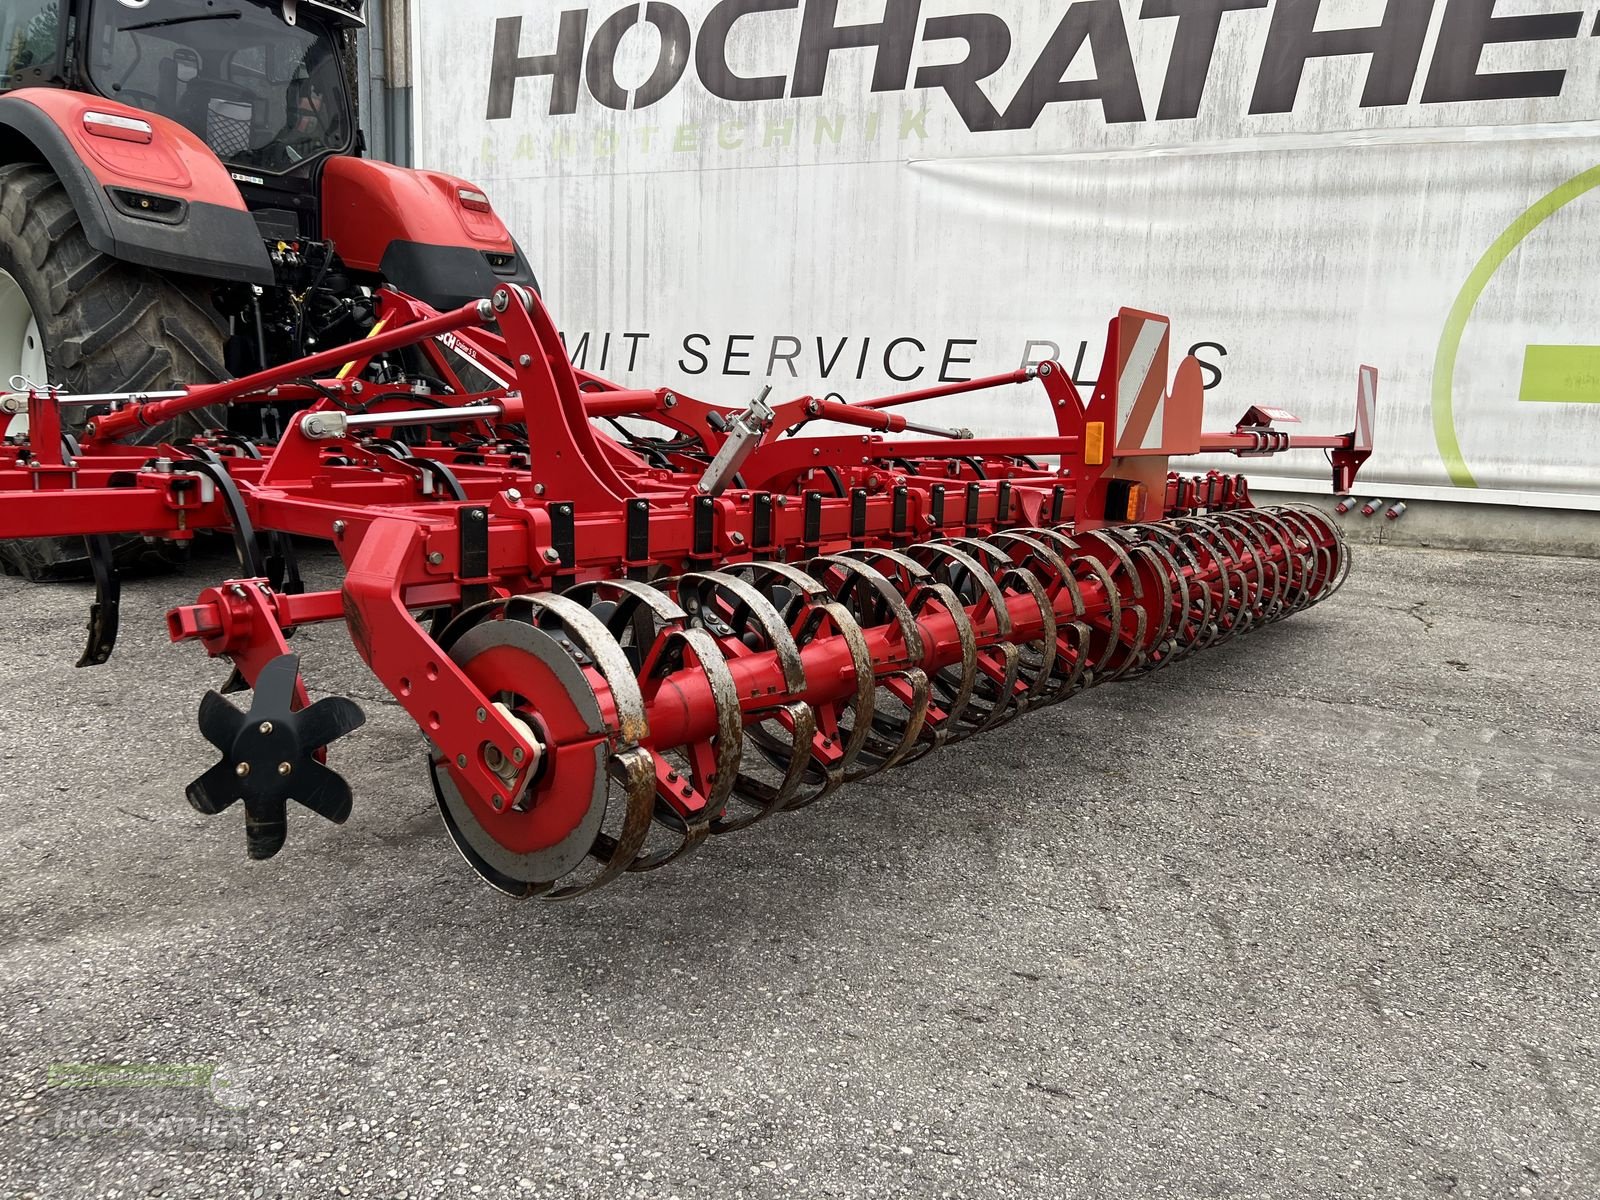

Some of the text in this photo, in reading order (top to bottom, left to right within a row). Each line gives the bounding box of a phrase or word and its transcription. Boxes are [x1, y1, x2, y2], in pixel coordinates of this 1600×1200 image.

[486, 0, 1600, 132] HOCHRATHE
[480, 108, 931, 163] LANDTECHNIK
[558, 332, 1228, 391] MIT SERVICE PLS
